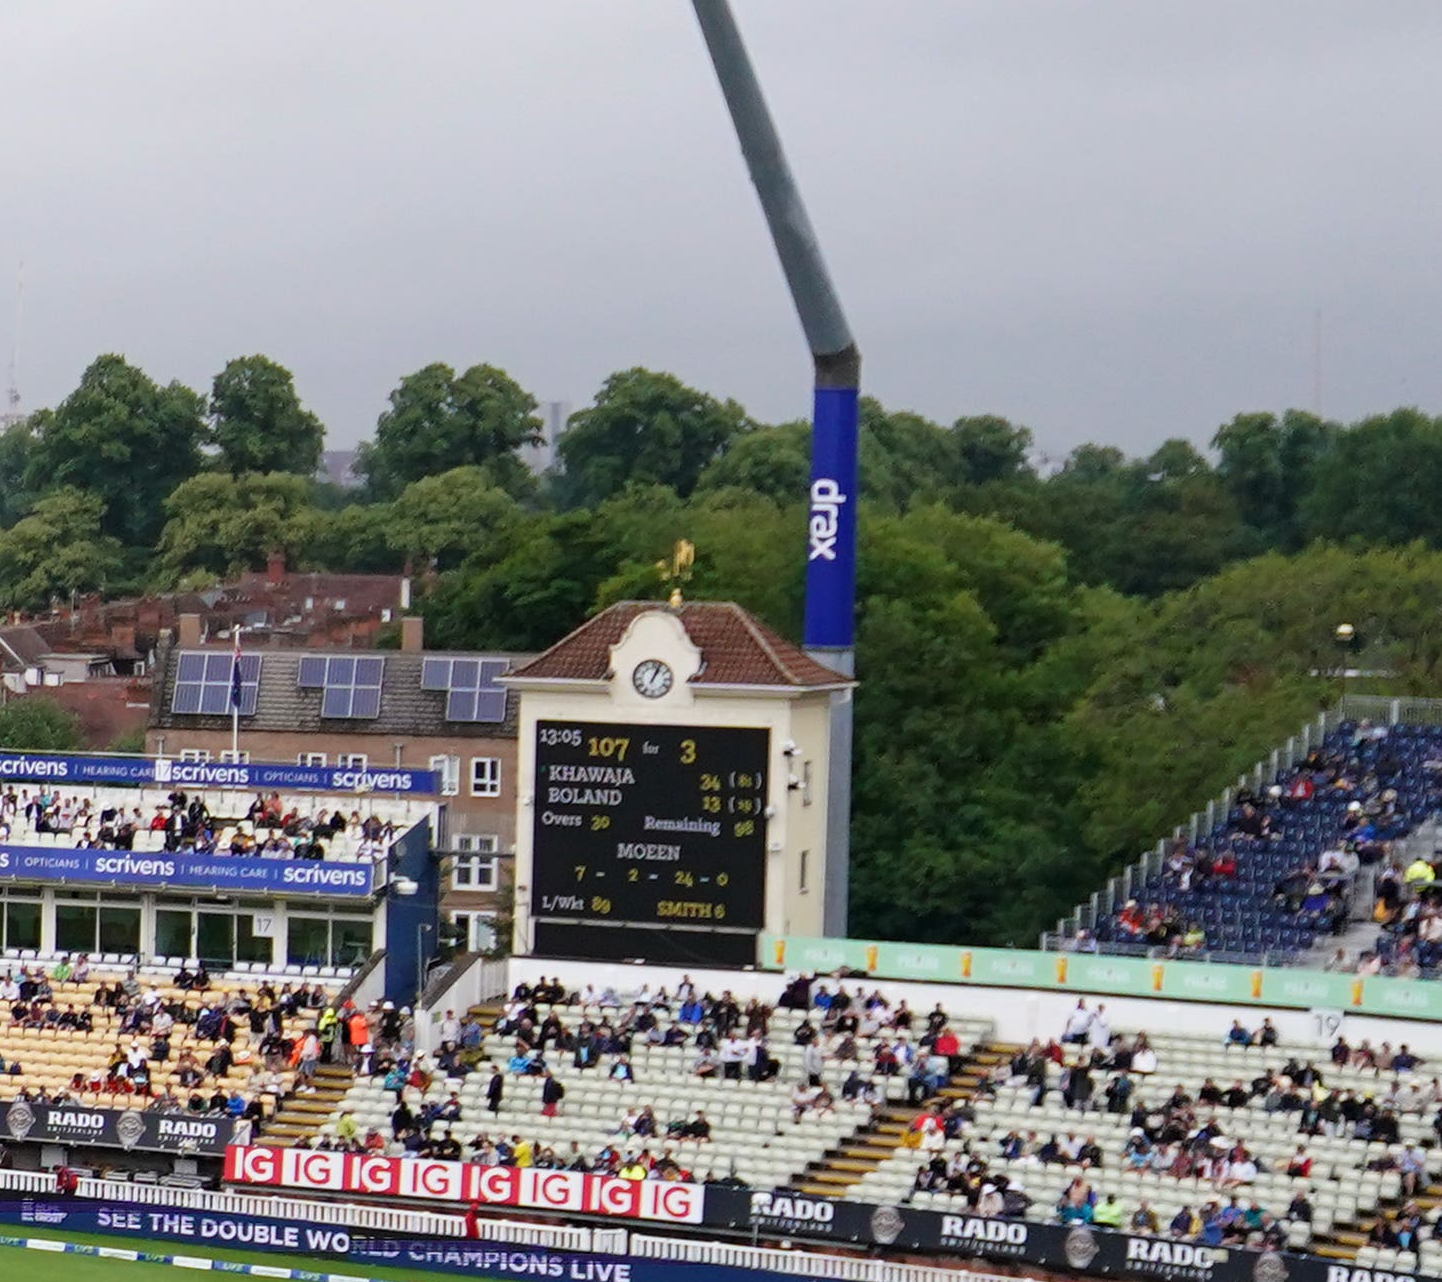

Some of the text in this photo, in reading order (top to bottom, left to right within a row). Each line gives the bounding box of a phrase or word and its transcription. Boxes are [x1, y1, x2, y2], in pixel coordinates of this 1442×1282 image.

[808, 477, 847, 560] drax
[539, 728, 582, 747] 13:05
[588, 737, 697, 764] 107 for 3
[82, 765, 123, 778] HEARING
[172, 763, 412, 790] scrivens scrivens
[549, 765, 636, 786] KHAWAJA
[548, 787, 622, 807] BOLAND
[542, 811, 583, 828] Overs
[644, 815, 721, 836] Remaining
[616, 842, 681, 862] MOEEN
[283, 866, 366, 887] scrivens
[257, 918, 273, 934] 17
[47, 1110, 105, 1129] RADO
[234, 1146, 276, 1183] IG
[295, 1152, 332, 1184] IG
[471, 1164, 514, 1202] IG
[532, 1174, 570, 1207] IG
[653, 1184, 691, 1217] IG
[751, 1192, 834, 1221] RADO
[97, 1207, 142, 1231] SEE
[148, 1213, 195, 1236] THE
[201, 1218, 300, 1248] DOUBLE
[941, 1213, 1028, 1245] RADO
